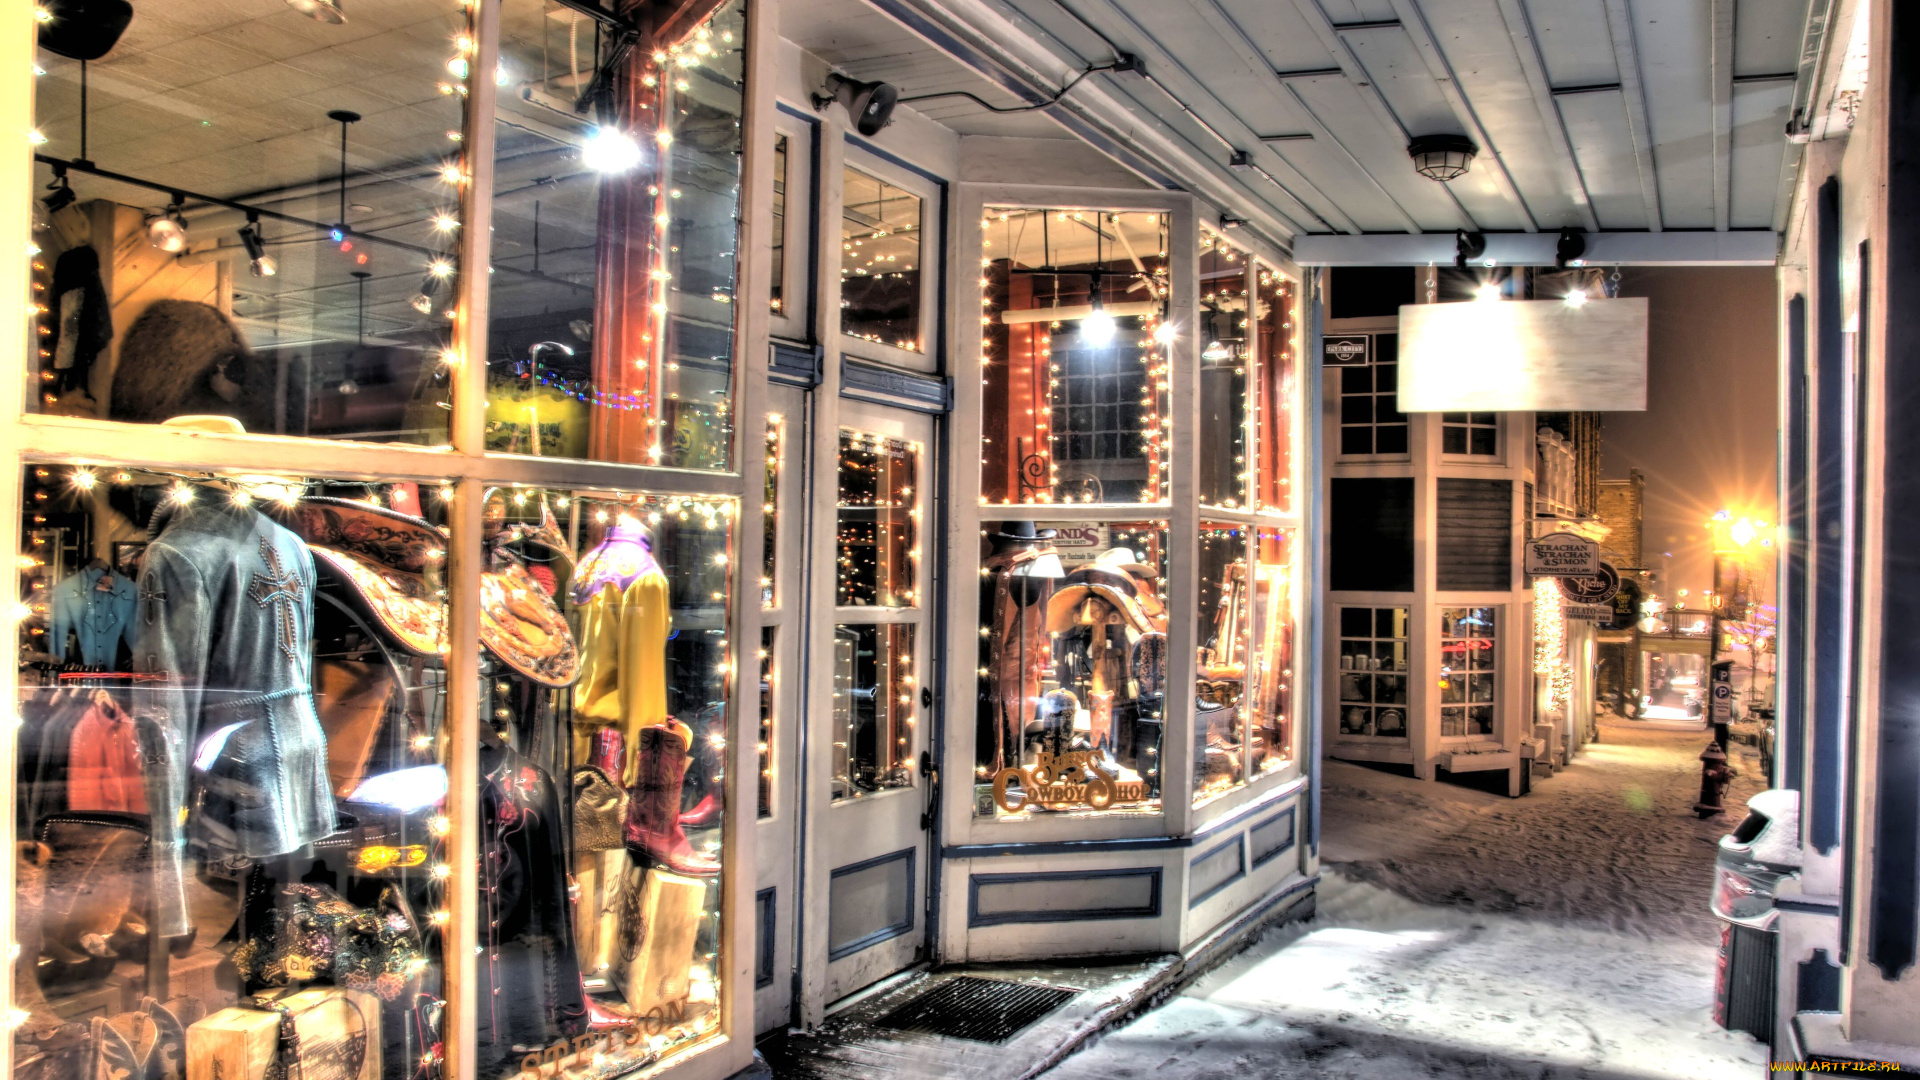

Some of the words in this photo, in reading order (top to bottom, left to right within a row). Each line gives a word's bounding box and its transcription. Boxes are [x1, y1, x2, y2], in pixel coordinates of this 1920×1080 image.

[1533, 544, 1588, 553] STRACHAN
[1536, 551, 1592, 559] STRACHAN
[992, 767, 1086, 813] COWBOY
[1085, 750, 1150, 810] SHOP
[520, 998, 688, 1080] STETSON
